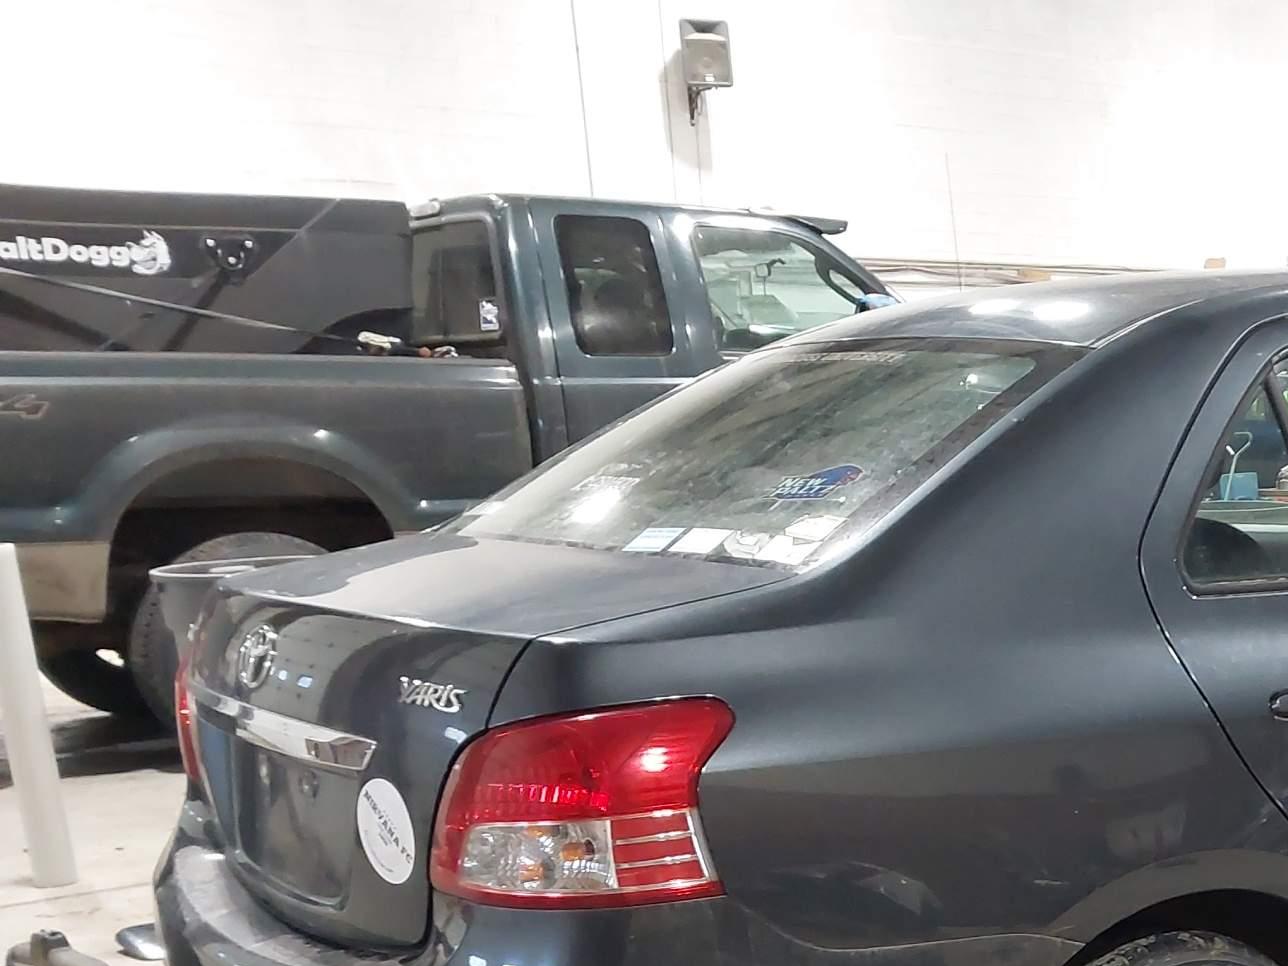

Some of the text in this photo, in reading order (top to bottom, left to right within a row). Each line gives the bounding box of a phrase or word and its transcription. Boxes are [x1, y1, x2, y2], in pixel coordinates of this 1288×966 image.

[0, 236, 131, 267] altDogg
[778, 478, 828, 487] NEW
[399, 676, 467, 713] YARIS
